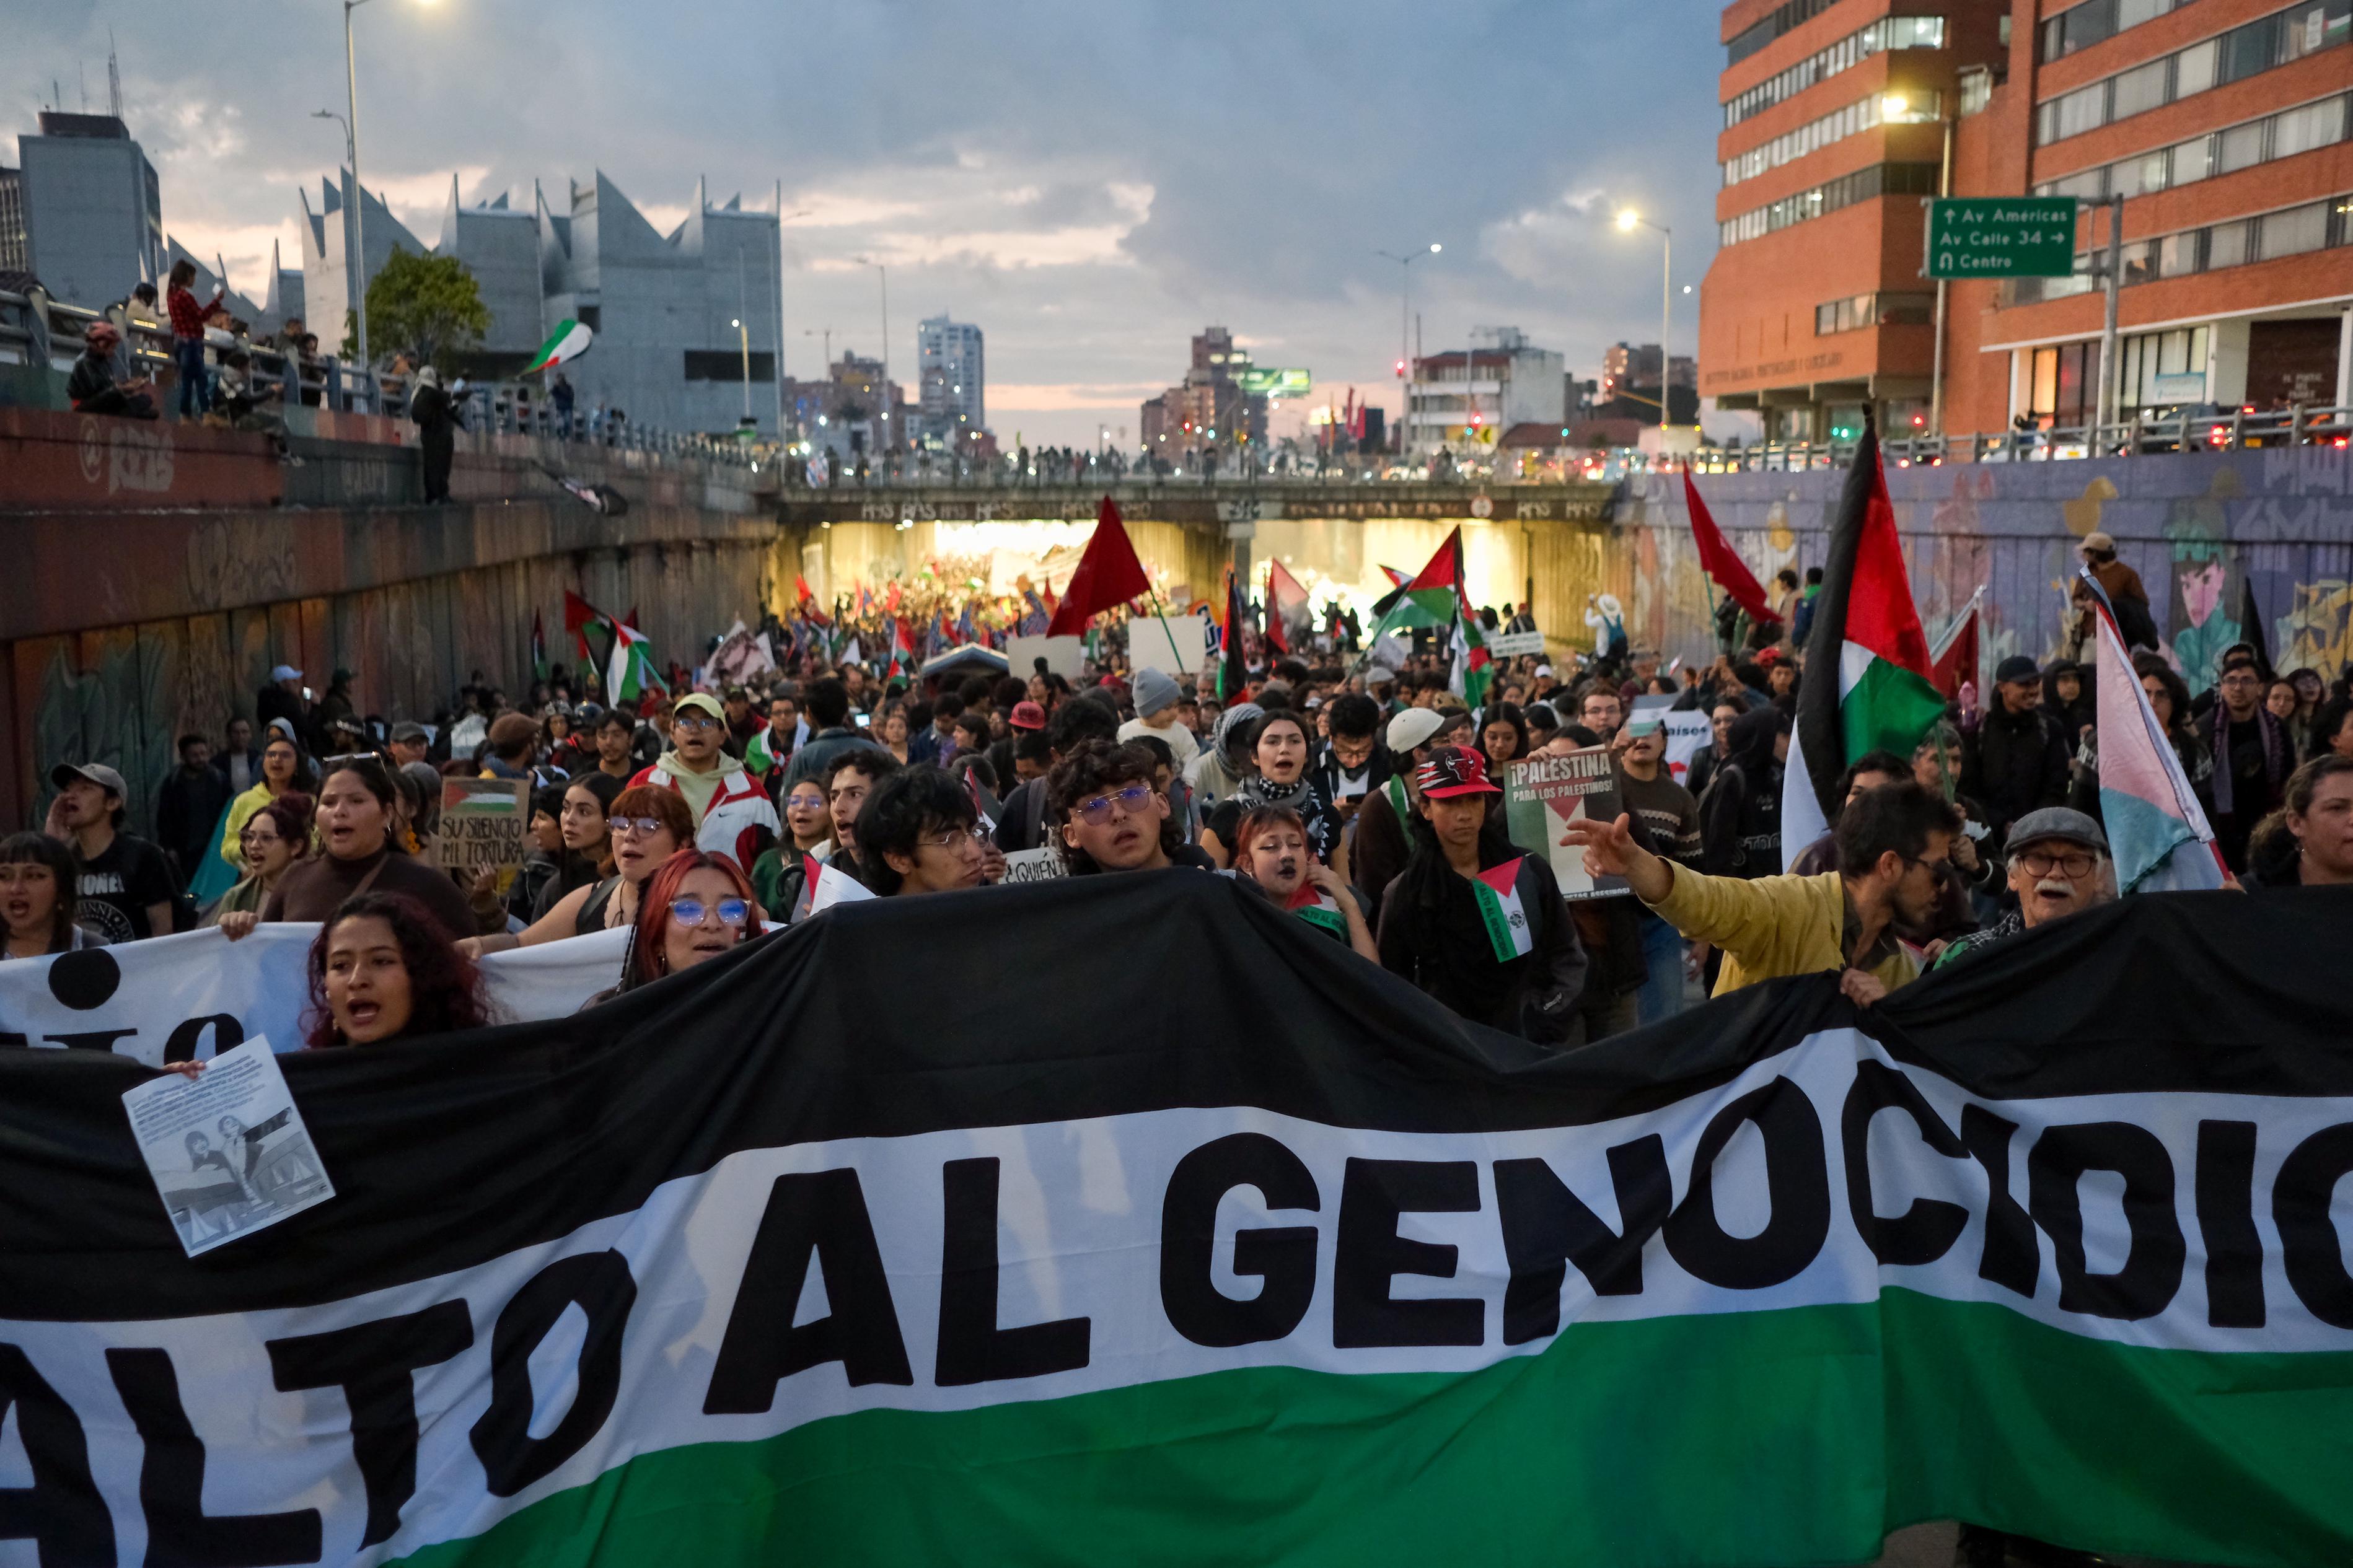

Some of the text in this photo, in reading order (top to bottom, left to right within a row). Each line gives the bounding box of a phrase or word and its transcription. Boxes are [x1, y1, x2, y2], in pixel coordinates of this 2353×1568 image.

[1962, 208, 2067, 222] Av Américas
[1940, 230, 2043, 245] Av Calle 34
[1959, 253, 2012, 268] Centro
[1510, 752, 1612, 787] ¡PALESTINA
[1512, 779, 1613, 803] PARA LOS PALESTINOS!
[442, 817, 522, 840] SU SILENCIO
[442, 839, 525, 865] MI TORTURA
[1485, 906, 1495, 918] AL
[703, 1156, 1091, 1415] AL
